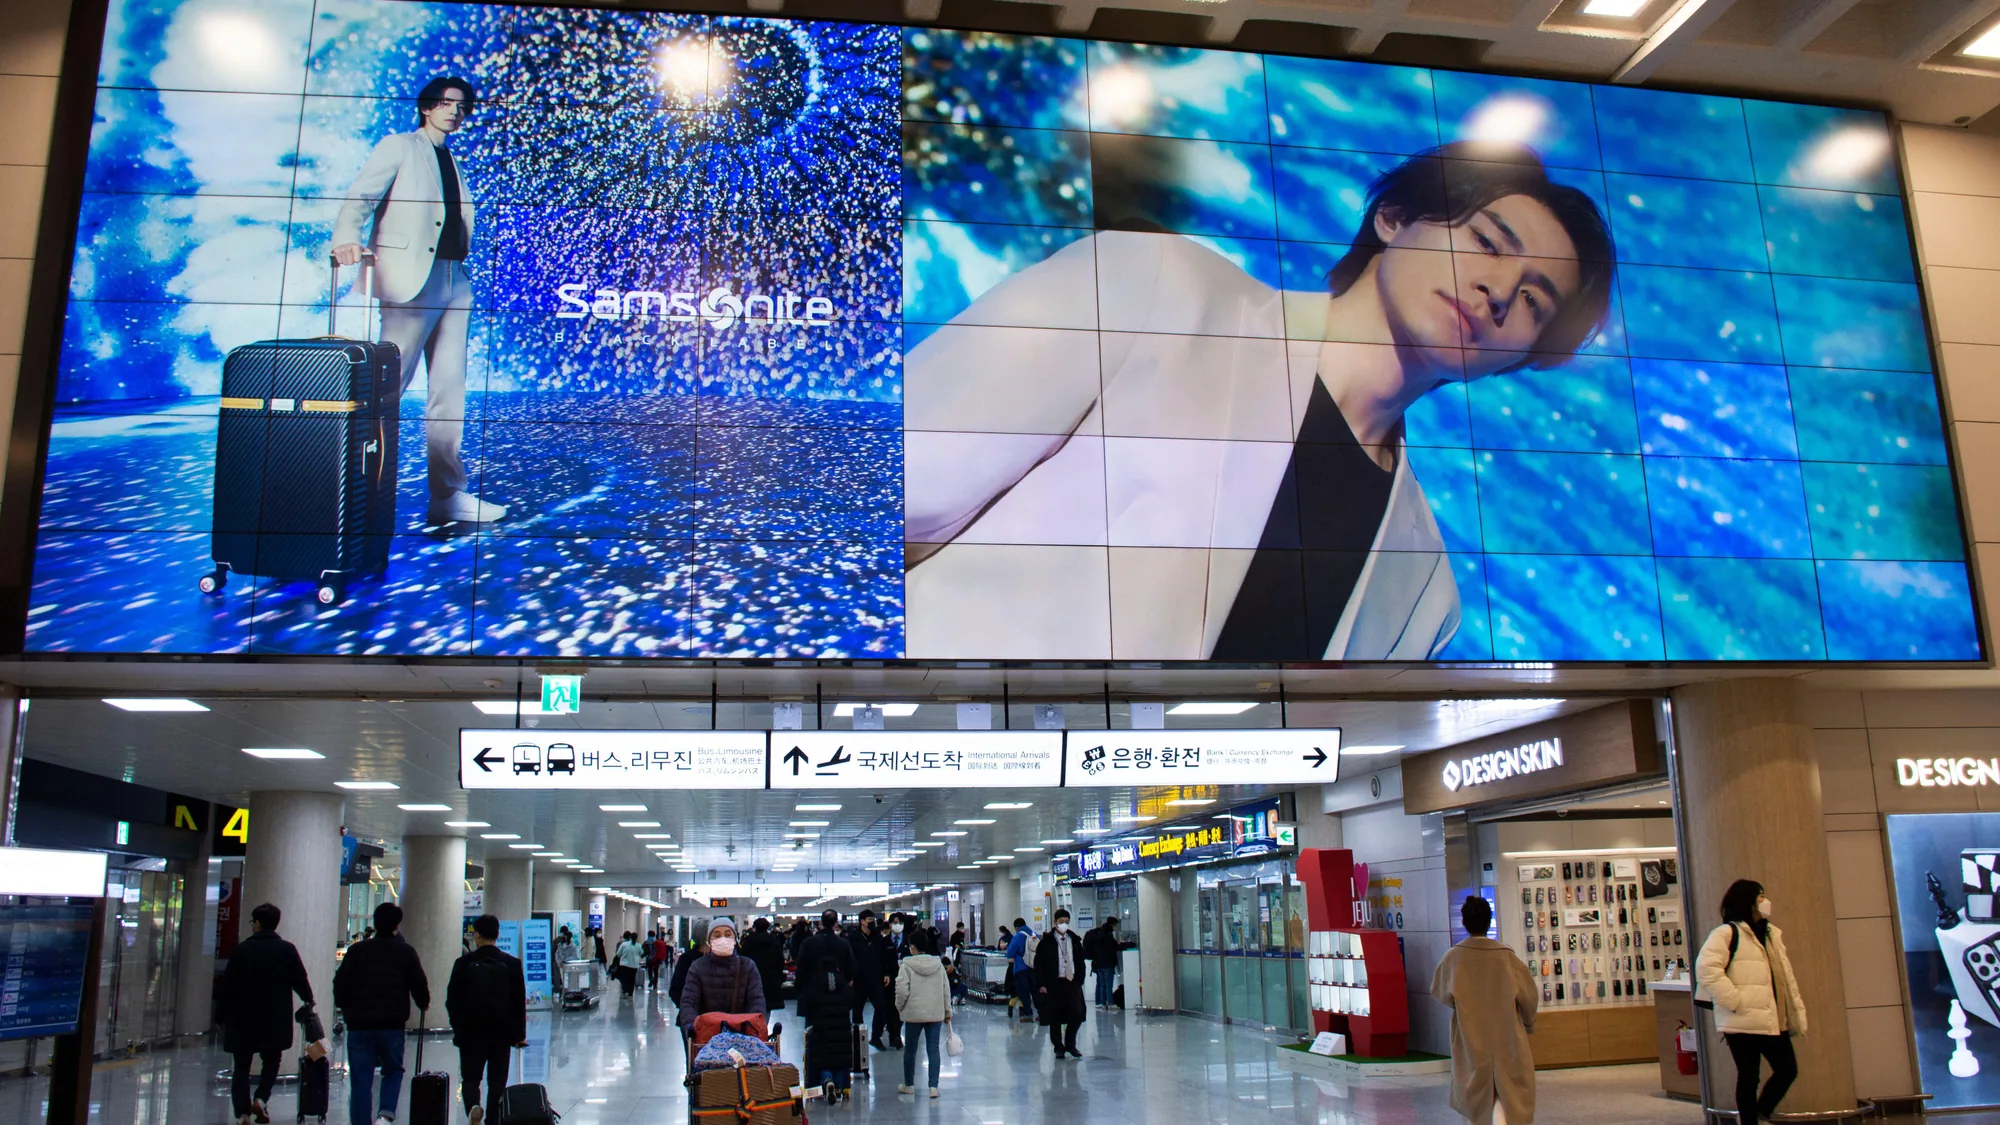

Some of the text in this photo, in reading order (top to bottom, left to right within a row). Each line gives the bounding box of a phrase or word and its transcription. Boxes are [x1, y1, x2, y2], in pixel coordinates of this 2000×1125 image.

[556, 283, 834, 330] Samsonite
[554, 332, 833, 351] BLACK LABEL
[582, 750, 692, 772] 버스,리무진
[857, 750, 963, 772] 국제선도착
[967, 751, 1050, 759] International Arrivals
[1229, 749, 1259, 757] Currency
[1261, 749, 1294, 757] Exchange
[222, 807, 249, 843] 4
[1350, 876, 1356, 898] I
[1351, 900, 1372, 927] JEJU
